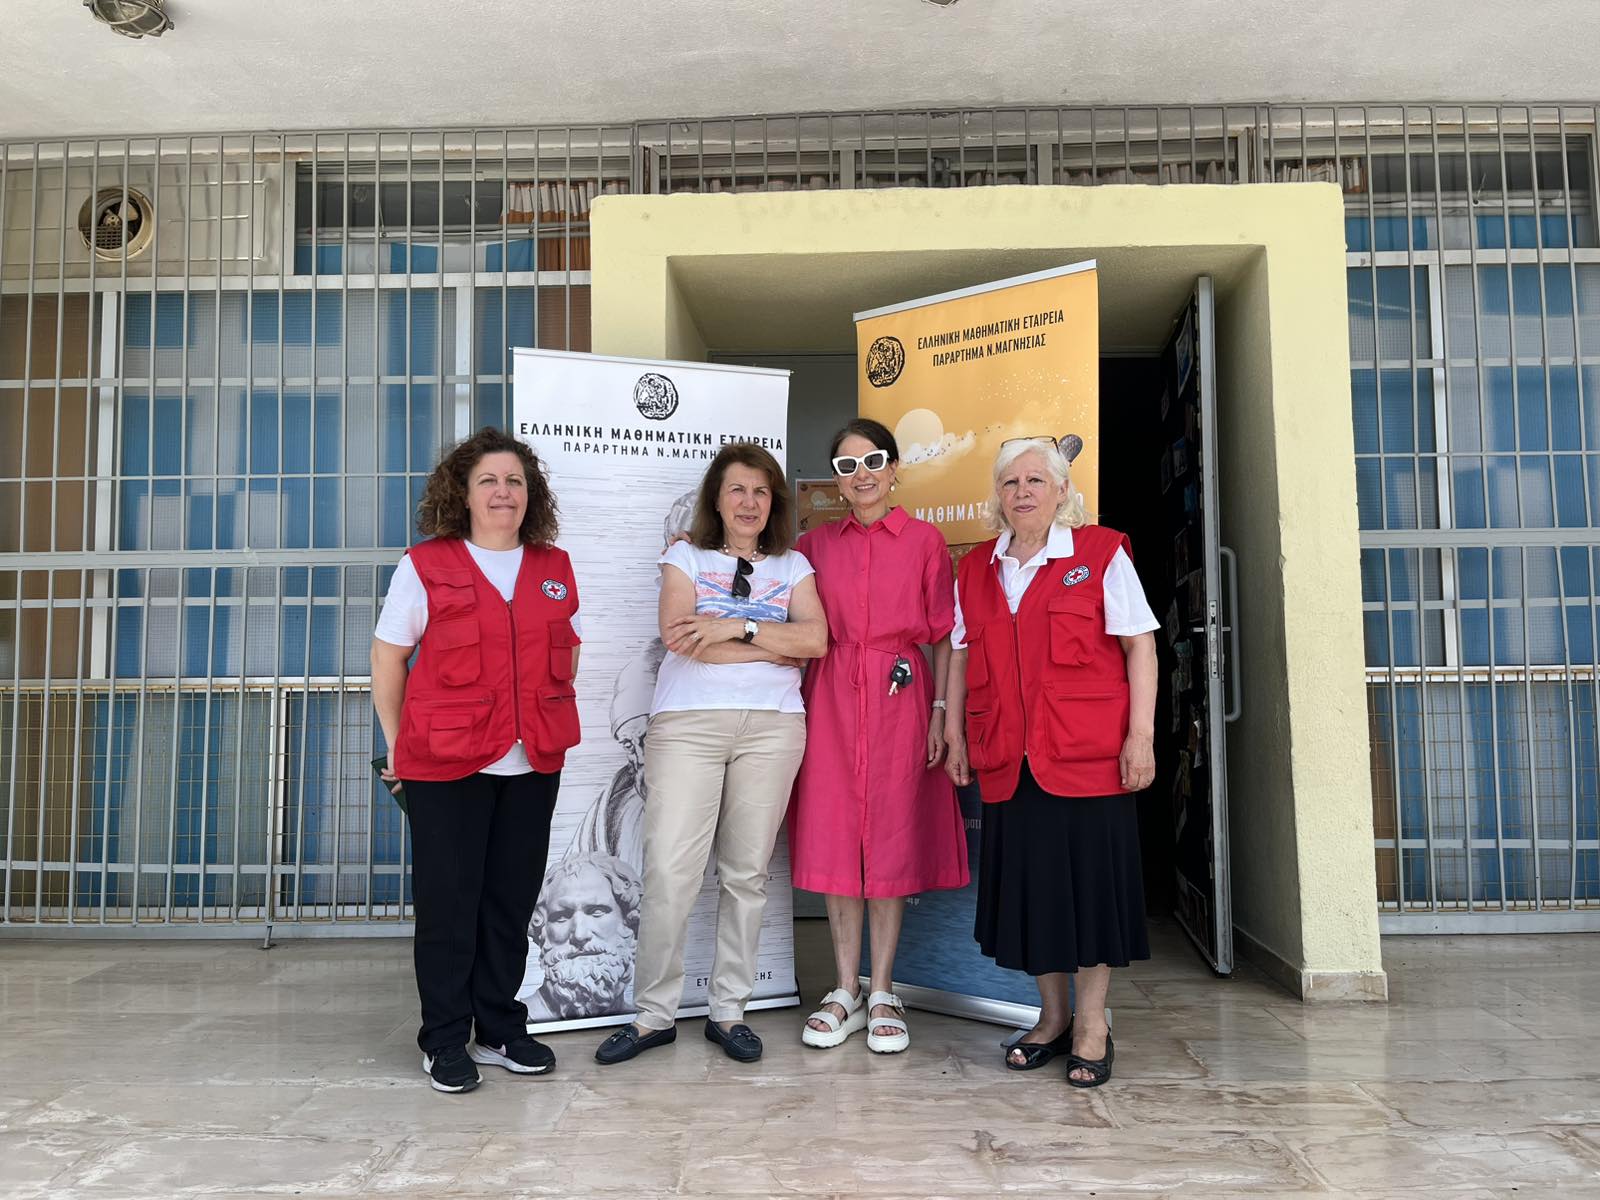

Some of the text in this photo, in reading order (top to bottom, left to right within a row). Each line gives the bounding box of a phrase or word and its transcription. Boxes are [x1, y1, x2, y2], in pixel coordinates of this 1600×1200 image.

[917, 309, 1064, 350] ΕΛΛΗΝΙΚΗ ΜΑΘΗΜΑΤΙΚΗ ΕΤΑΙΡΕΙΑ
[933, 333, 1046, 367] ΠΑΡΑΡΤΗΜΑ Ν.ΜΑΓΝΗΣΙΑΣ
[520, 423, 783, 450] ΕΛΛΗΝΙΚΗ ΜΑΘΗΜΑΤΙΚΗ ΕΤΑΙΡΕΙΑ
[563, 441, 717, 459] ΠΑΡΑΡΤΗΜΑ Ν.ΜΑΓΝΗ
